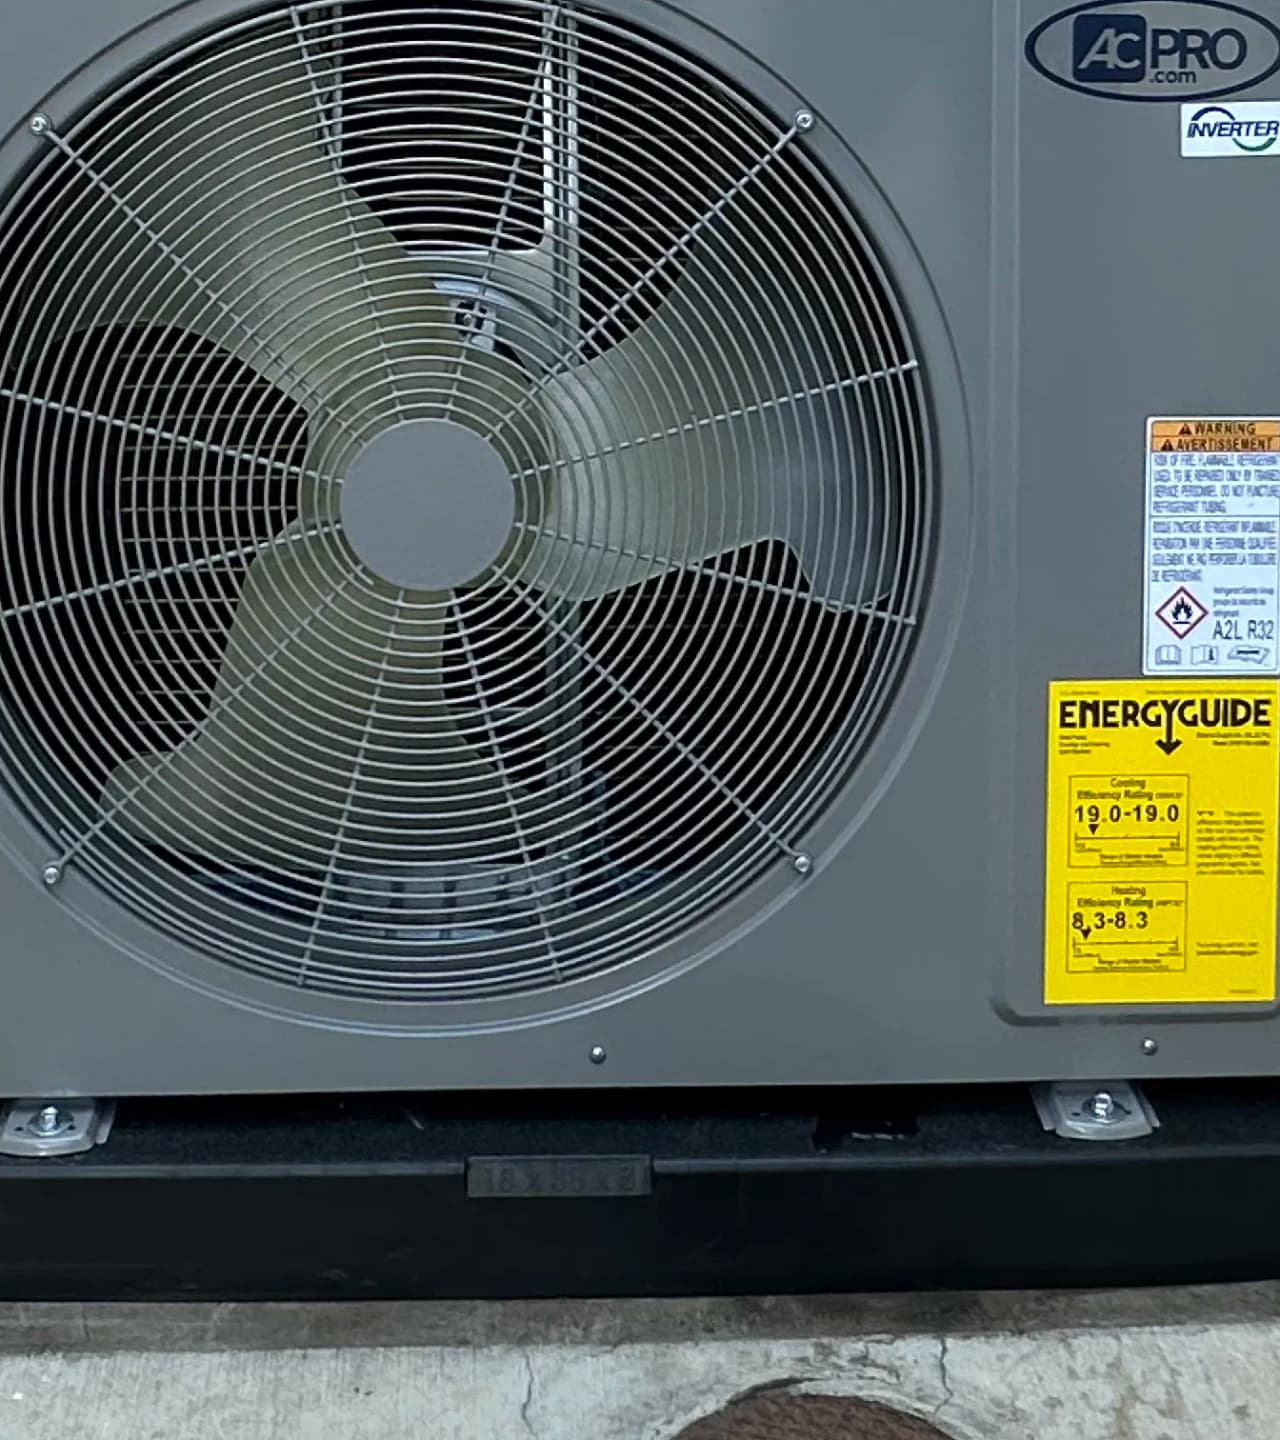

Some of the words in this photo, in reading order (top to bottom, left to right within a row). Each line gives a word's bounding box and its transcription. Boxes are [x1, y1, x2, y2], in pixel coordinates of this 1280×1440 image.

[1186, 119, 1280, 139] INVERTER
[1194, 422, 1257, 435] WARNING
[1176, 437, 1274, 451] AVERTISSEMENT
[1212, 619, 1244, 640] A2L
[1247, 619, 1275, 641] R32
[1058, 697, 1272, 730] ENERGYGUIDE
[1110, 777, 1146, 790] Cooling
[1124, 789, 1154, 801] Rating
[1074, 803, 1180, 823] 19.0-19.0
[1111, 886, 1147, 897] Heating
[1124, 897, 1154, 909] Rating
